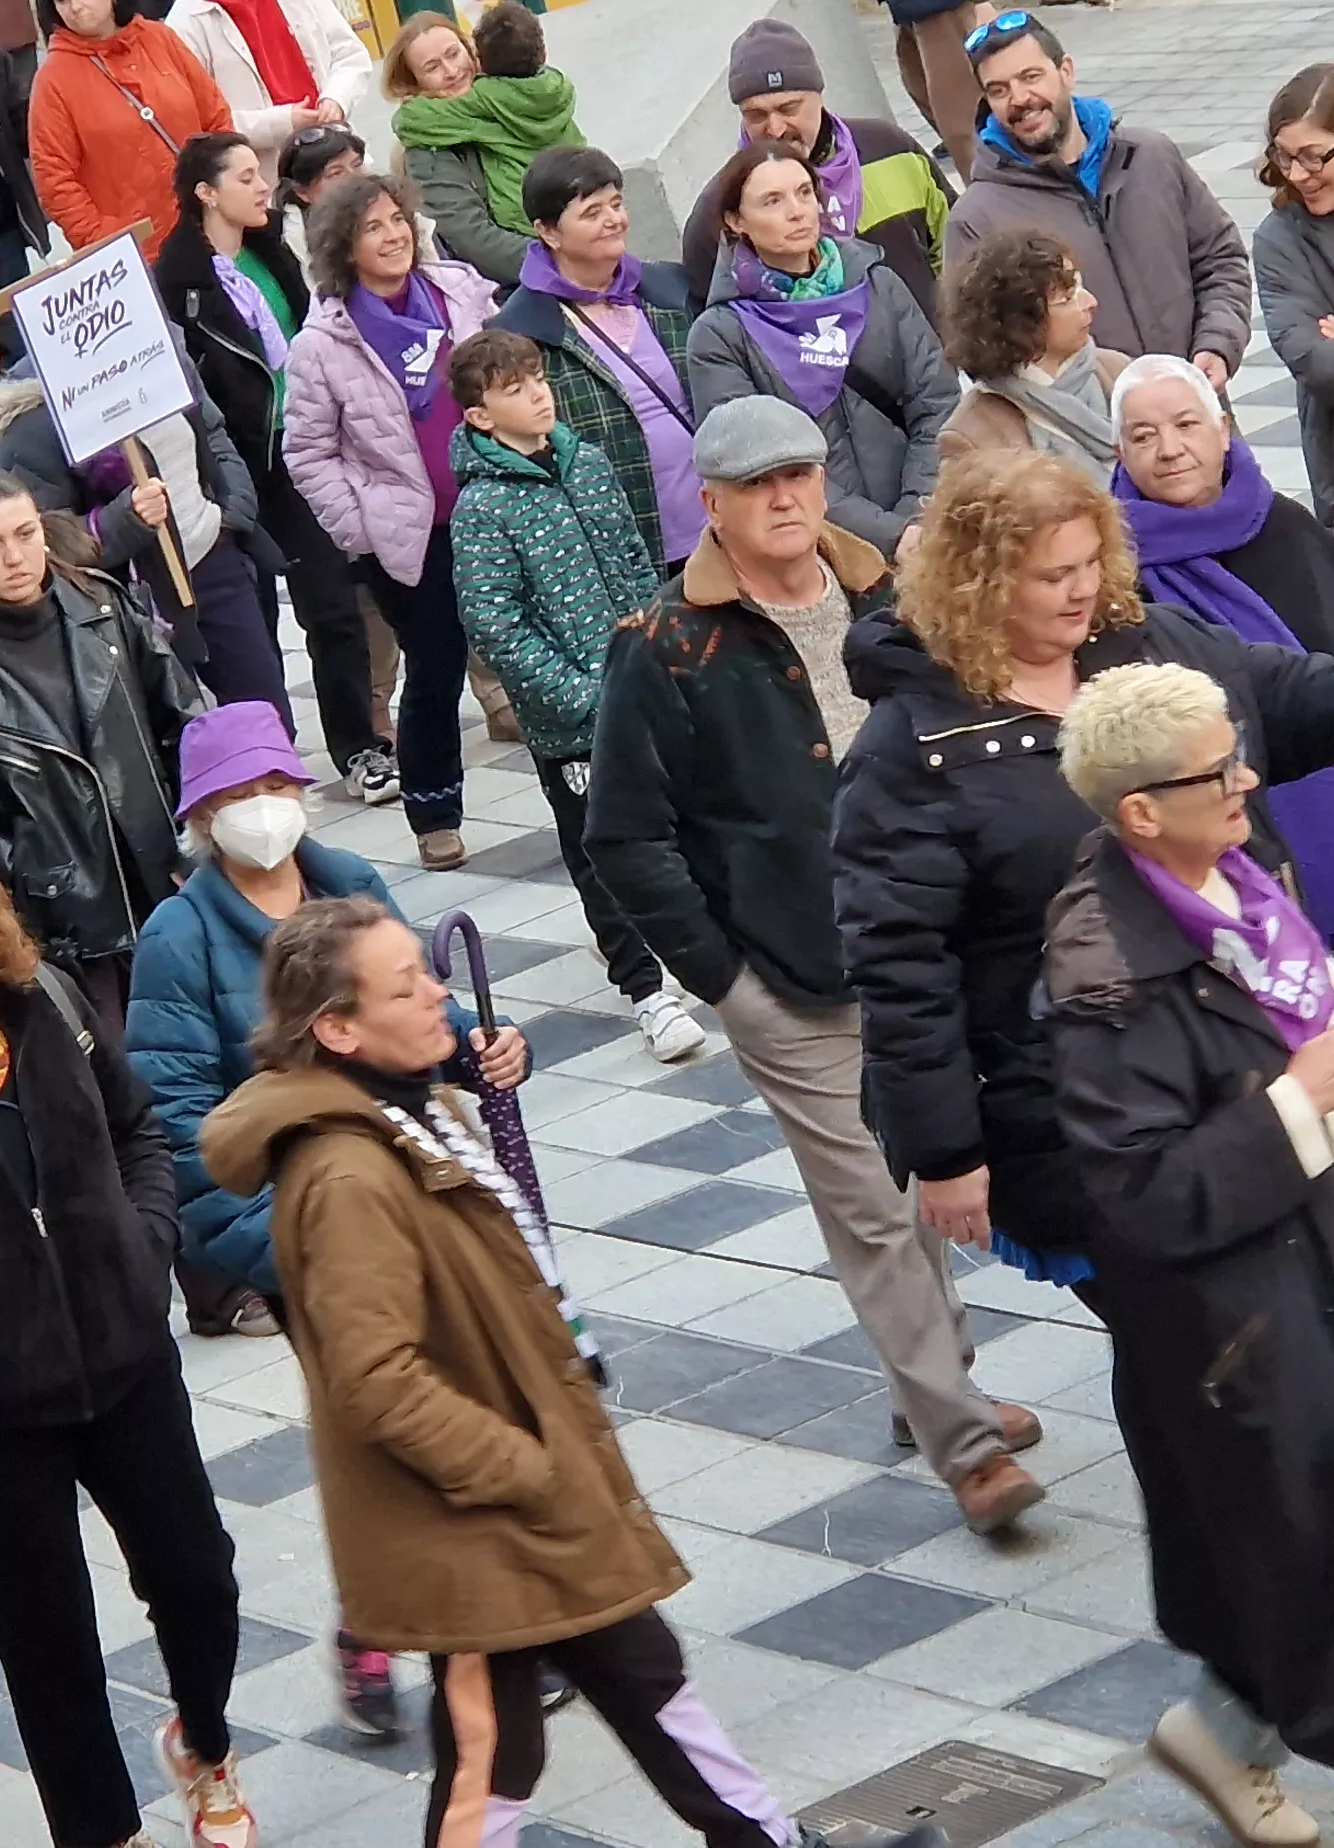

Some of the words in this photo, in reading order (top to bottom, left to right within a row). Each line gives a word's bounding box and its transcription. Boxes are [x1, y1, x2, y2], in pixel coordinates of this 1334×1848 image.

[41, 258, 128, 336] JUNTAS
[59, 301, 100, 329] CONTRA
[61, 331, 73, 345] EL
[74, 299, 126, 359] ODIO
[401, 342, 425, 363] 8M
[799, 351, 850, 367] HUESCA
[61, 386, 76, 412] NI
[77, 383, 89, 396] UN
[91, 359, 128, 391] PASO
[130, 340, 165, 367] ATRÁS
